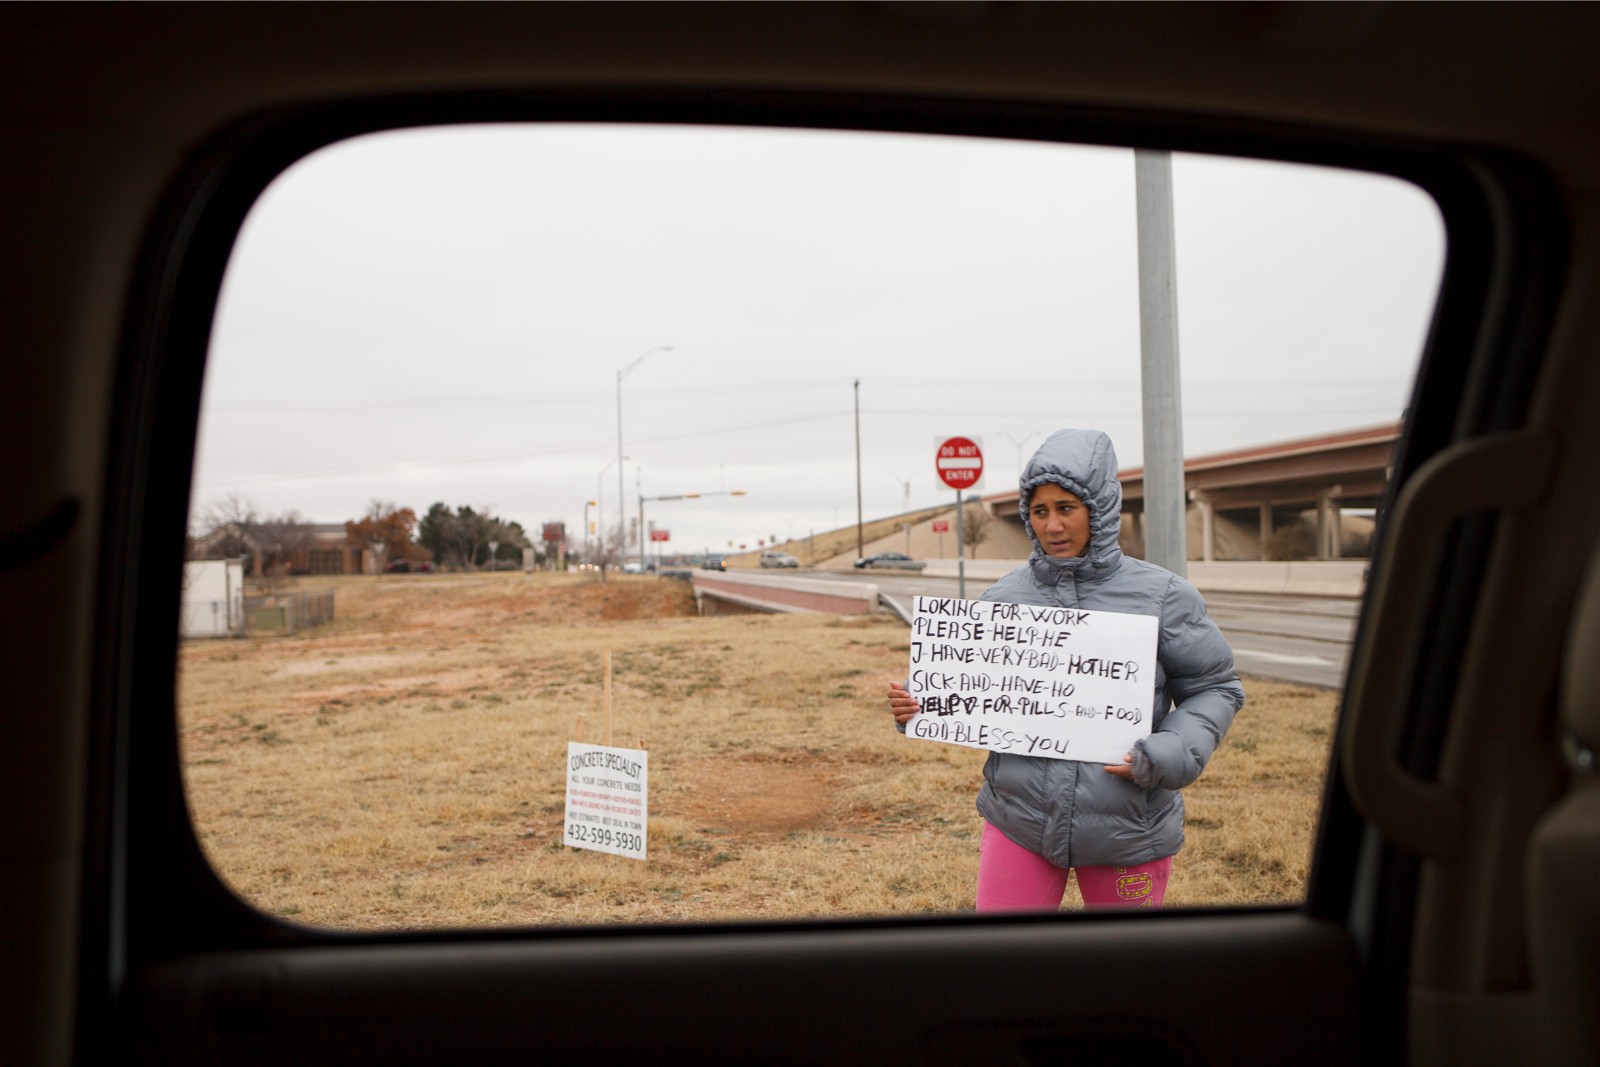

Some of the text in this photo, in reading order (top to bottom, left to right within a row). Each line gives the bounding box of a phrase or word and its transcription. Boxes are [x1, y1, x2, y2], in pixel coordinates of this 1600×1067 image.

[941, 445, 977, 457] DO NOT
[945, 469, 975, 481] ENTER
[570, 751, 642, 780] CONCRETE SPECIALIST
[597, 777, 623, 791] CONCRETE
[568, 823, 642, 852] 432-599-5930
